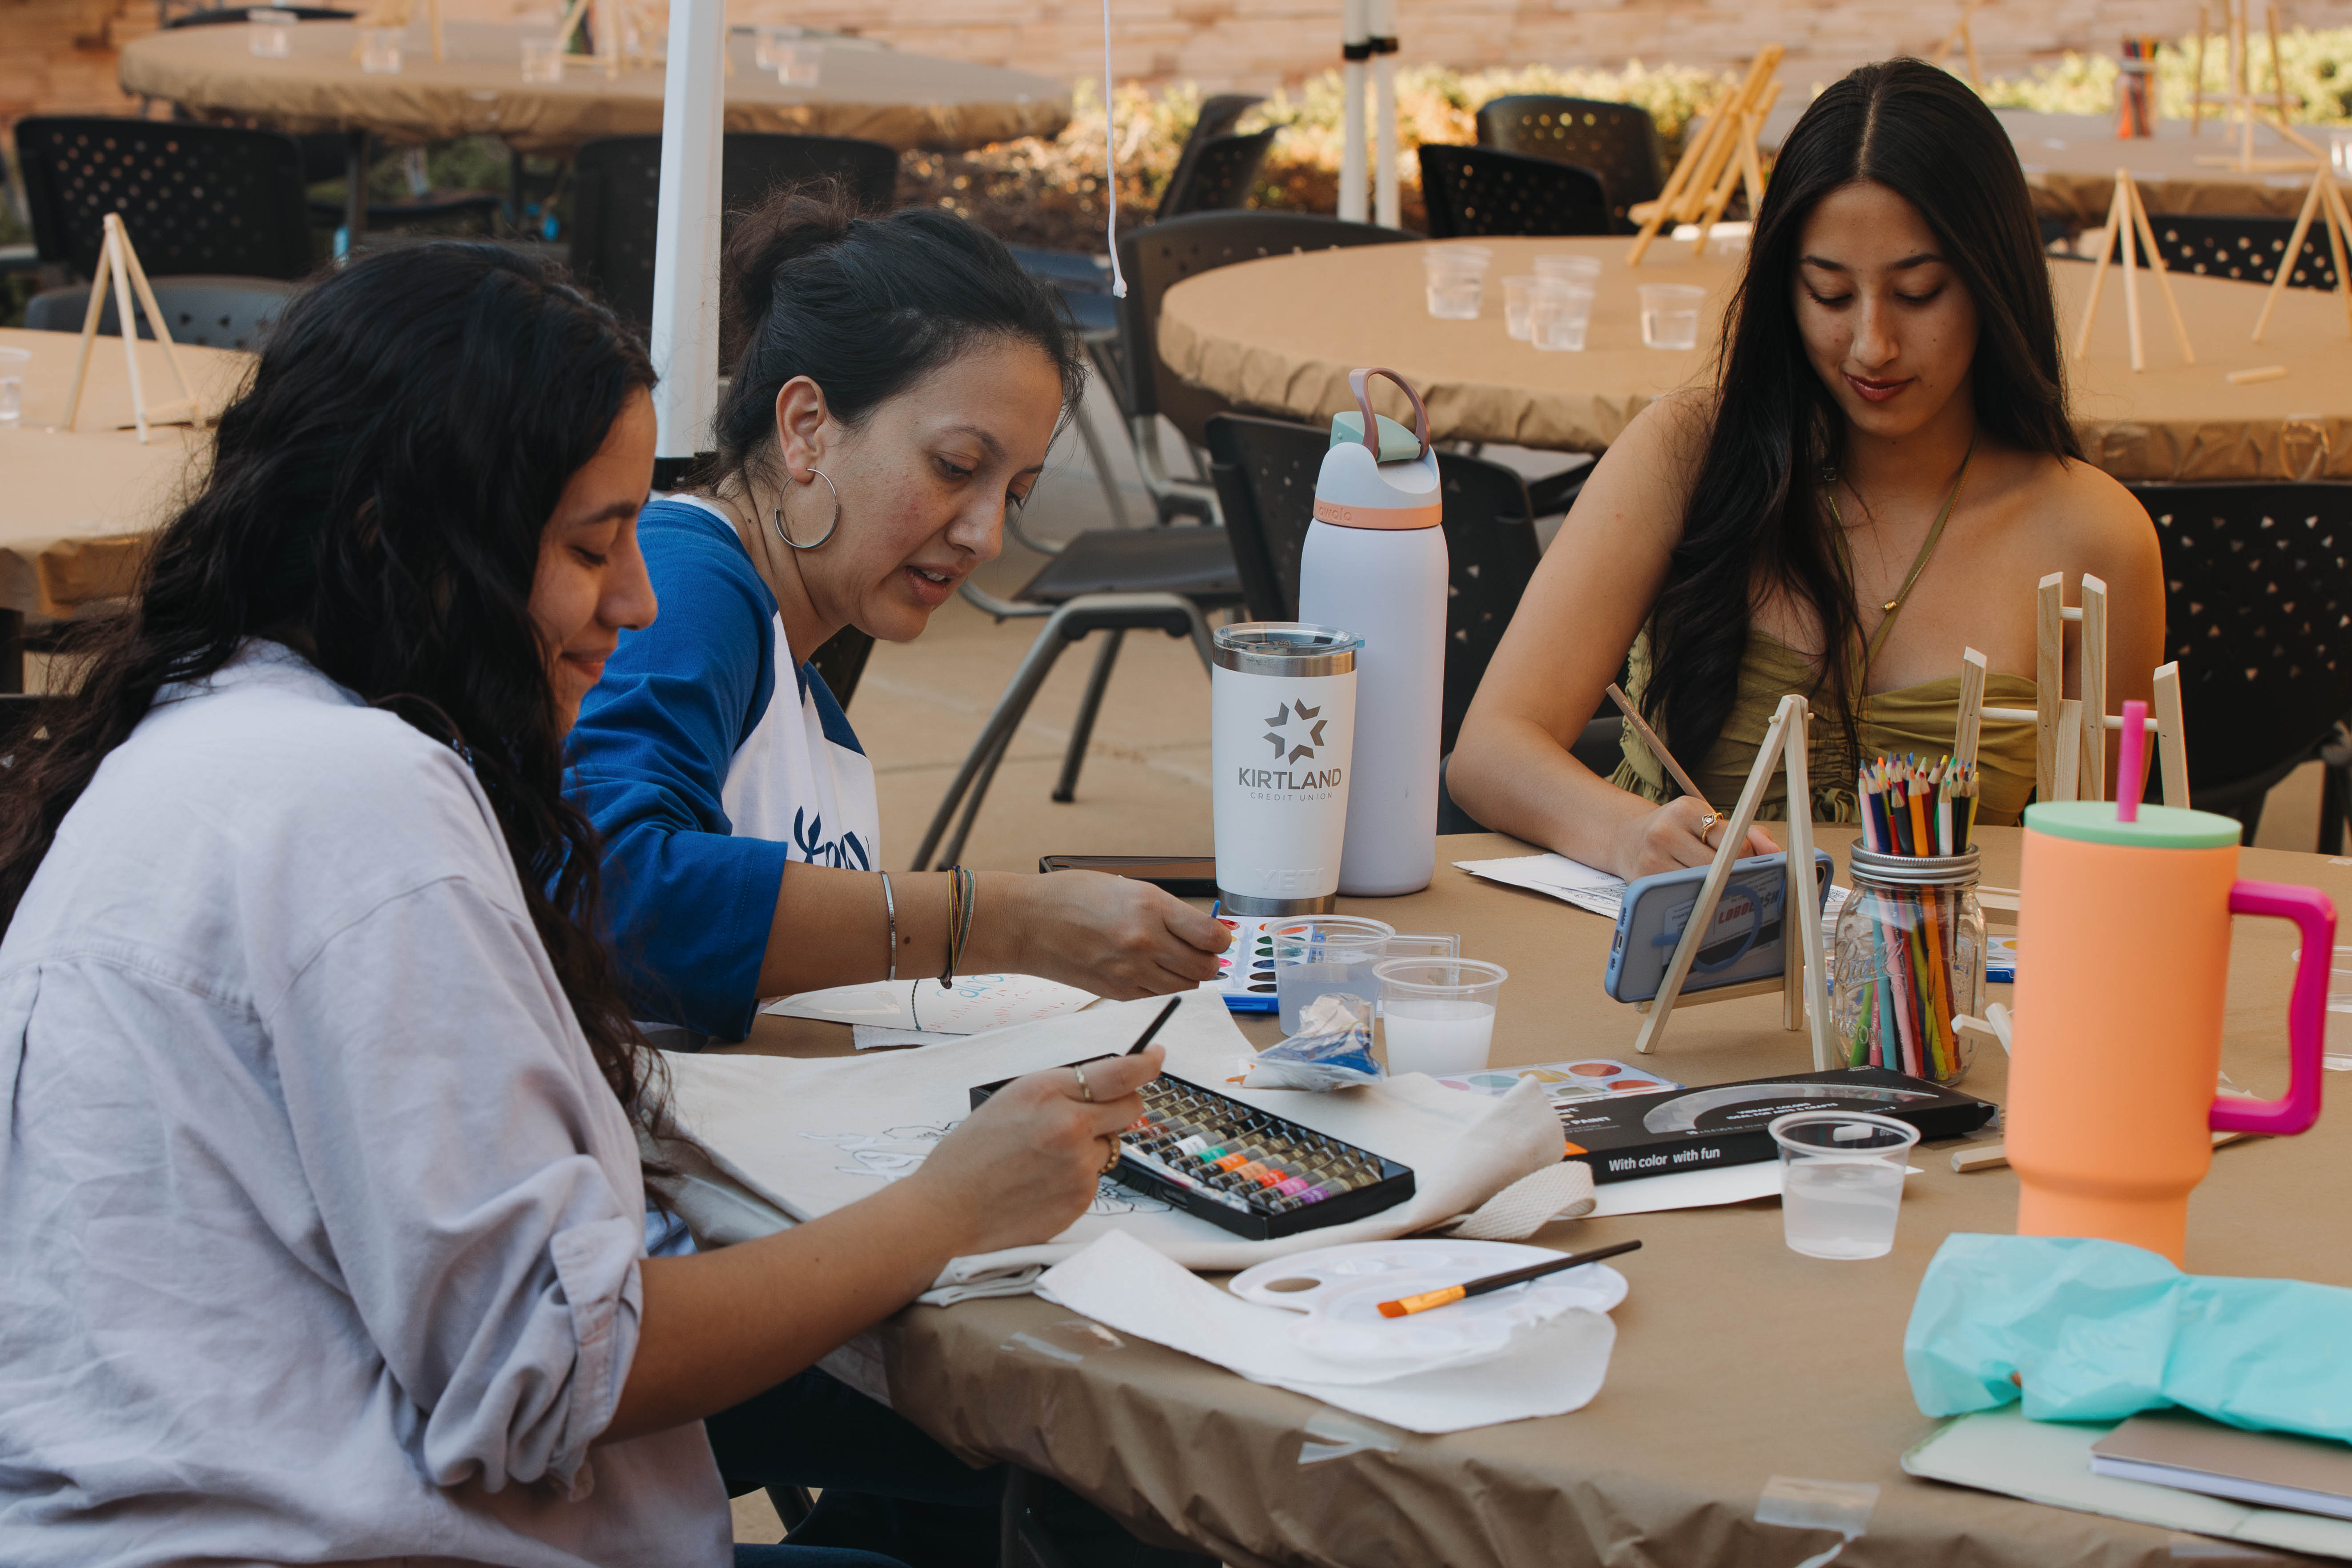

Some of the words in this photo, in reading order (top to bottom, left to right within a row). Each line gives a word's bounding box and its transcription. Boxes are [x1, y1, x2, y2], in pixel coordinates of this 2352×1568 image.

[1319, 506, 1353, 521] owala
[1239, 767, 1341, 790] KIRTLAND
[1250, 792, 1293, 801] CREDIT
[1300, 792, 1332, 801] UNION
[1256, 868, 1324, 891] YETI
[1609, 1157, 1636, 1171] With
[1639, 1154, 1668, 1168] color
[1673, 1150, 1699, 1163] with
[1701, 1147, 1721, 1159] fun
